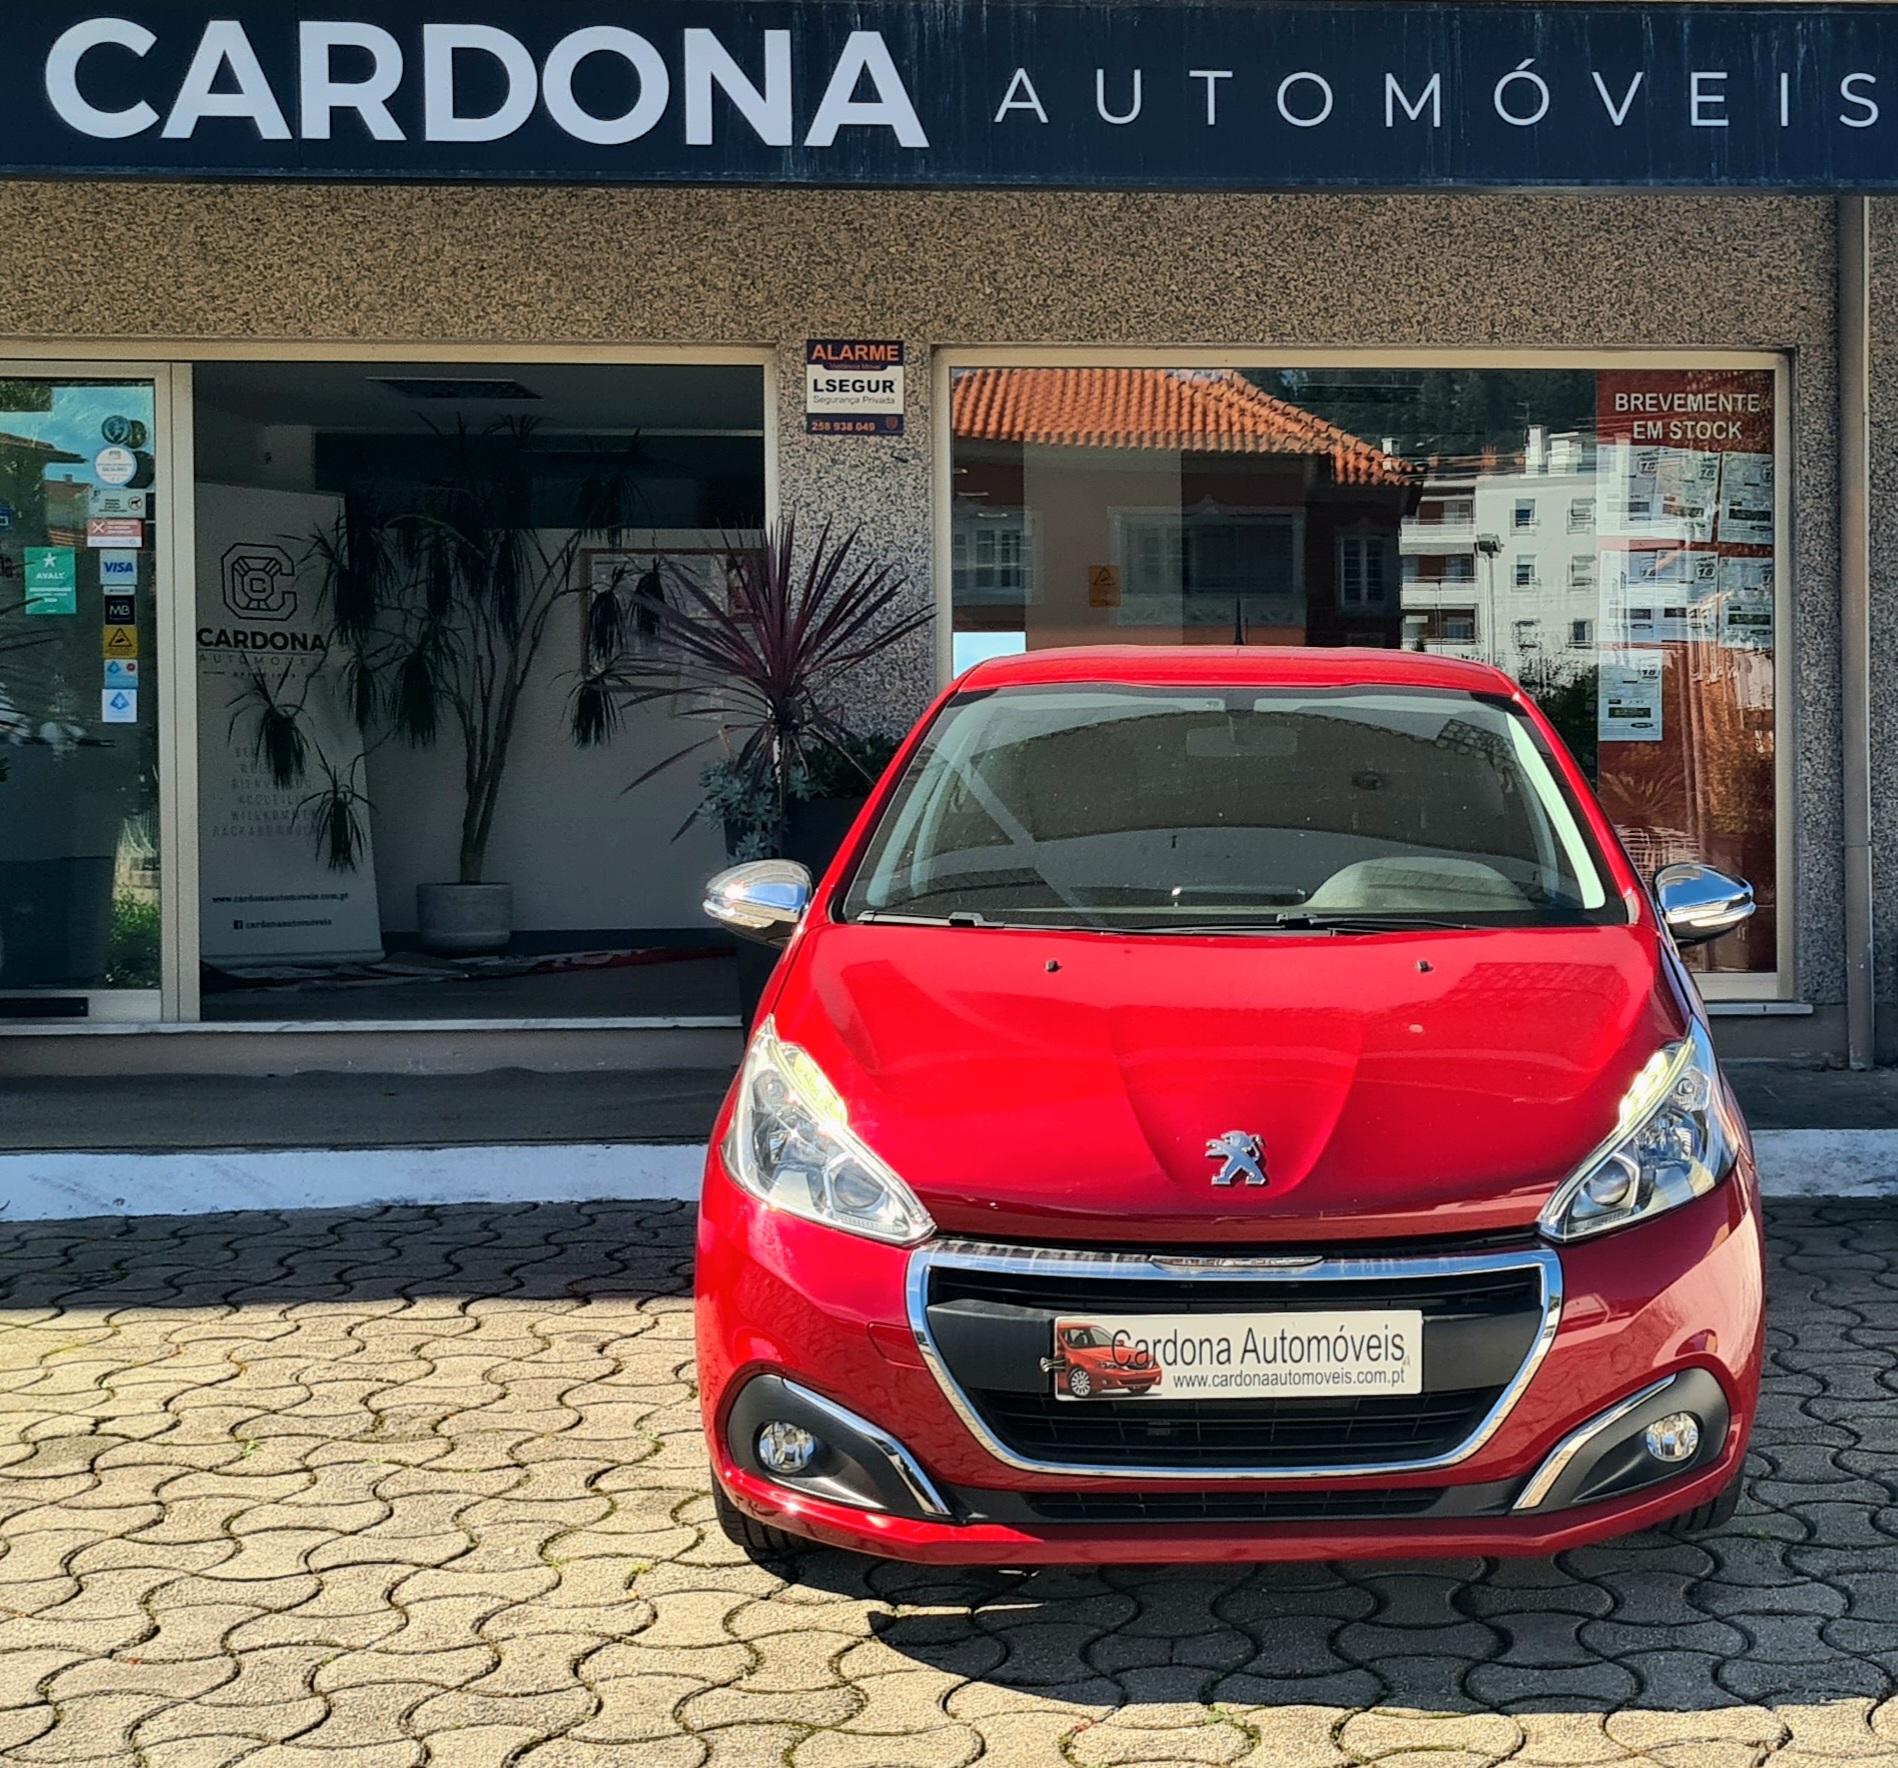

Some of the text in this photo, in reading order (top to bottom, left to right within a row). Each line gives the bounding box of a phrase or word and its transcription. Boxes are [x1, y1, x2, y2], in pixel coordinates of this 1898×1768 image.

[44, 16, 1879, 148] CARDONA AUTOMÓVEIS
[811, 344, 899, 361] ALARME
[813, 379, 895, 393] LSEGUR
[813, 394, 896, 405] Segurança Privada
[1615, 392, 1760, 412] BREVEMENTE
[1633, 420, 1742, 440] EM STOCK
[103, 562, 133, 573] VISA
[197, 627, 327, 652] CARDONA
[1111, 1323, 1405, 1367] Cardona Automóveis
[1173, 1367, 1405, 1389] www.cardonaautomoveis.com.pt
